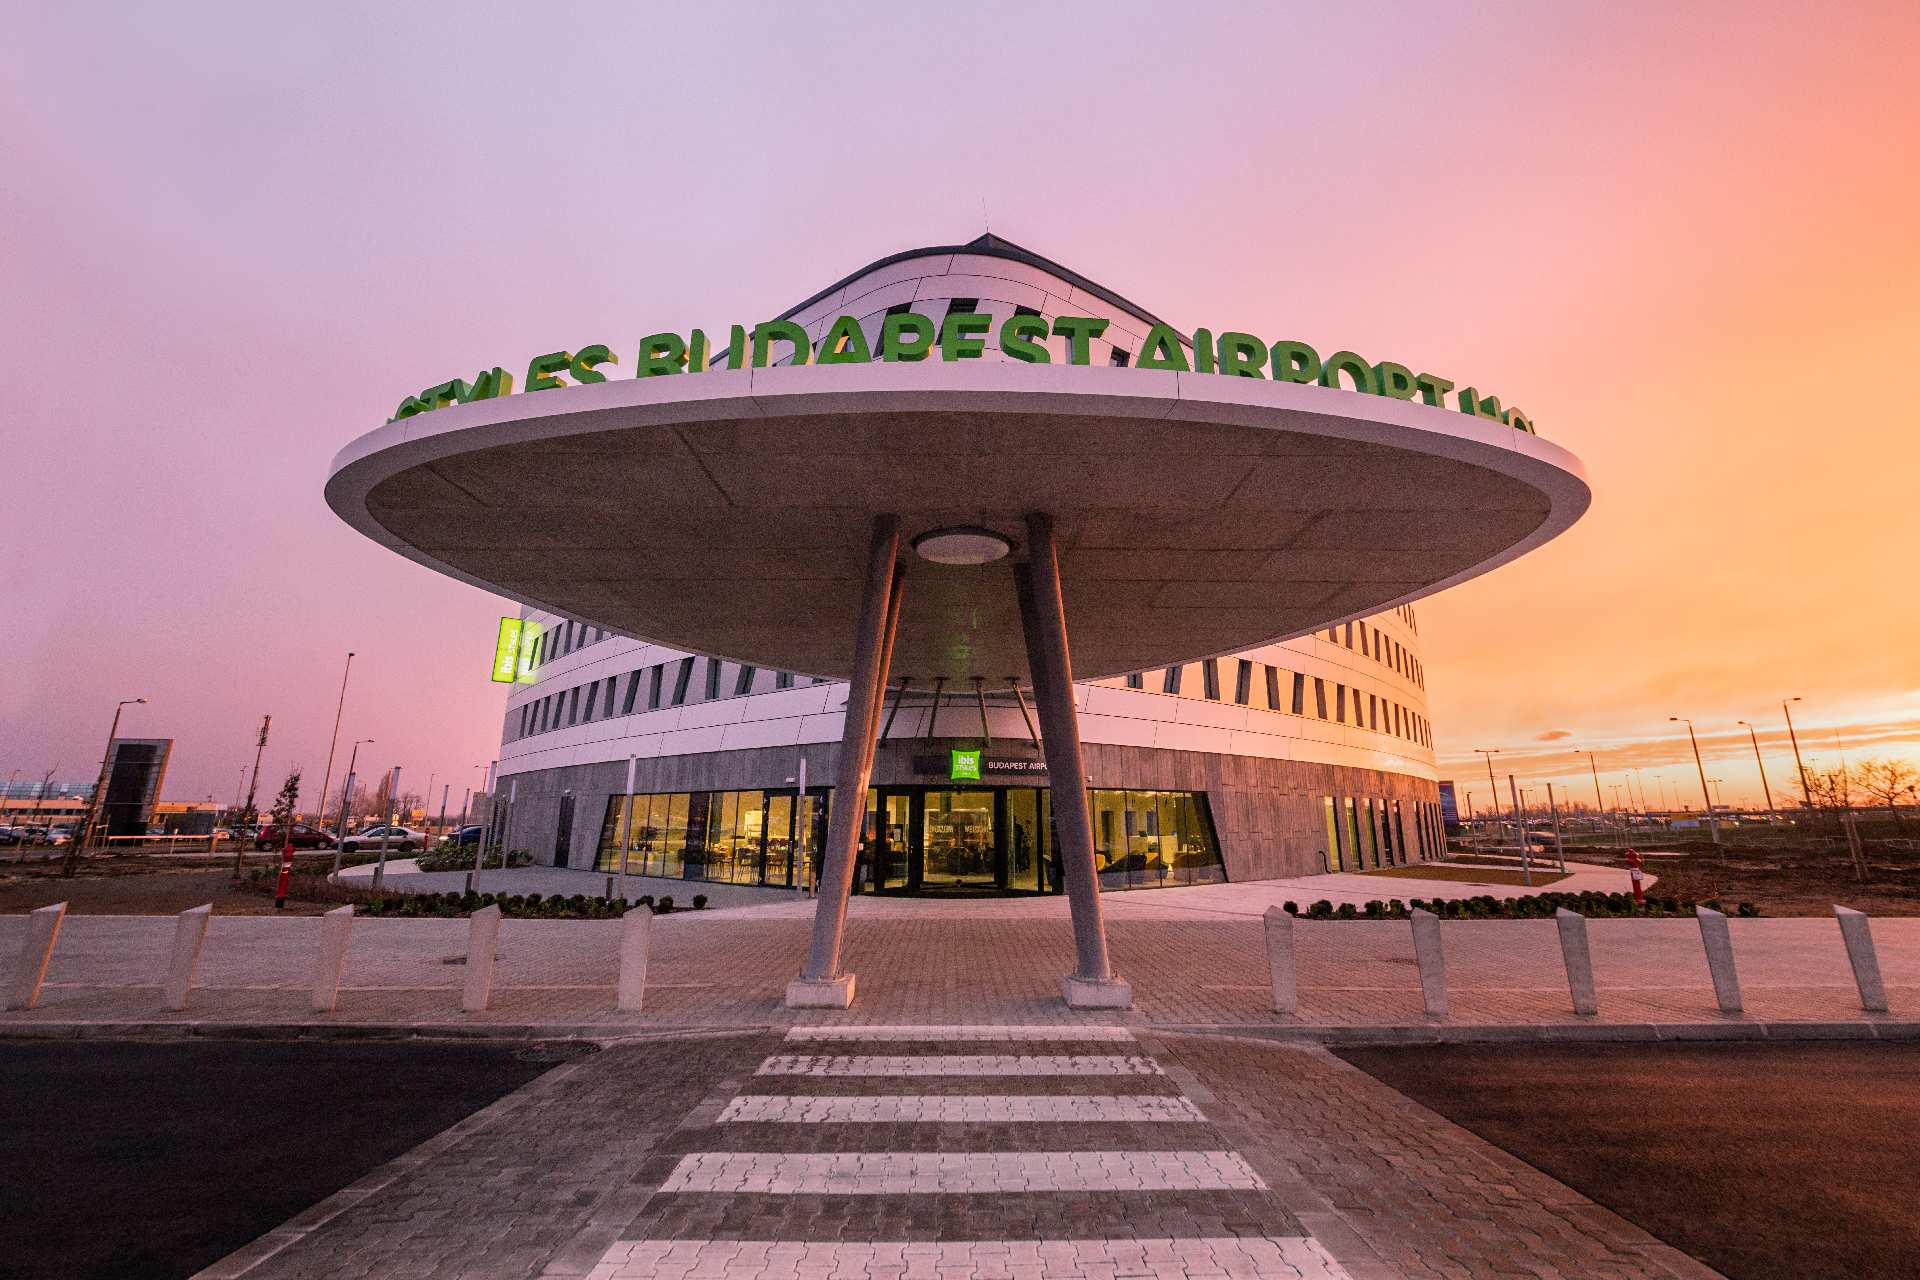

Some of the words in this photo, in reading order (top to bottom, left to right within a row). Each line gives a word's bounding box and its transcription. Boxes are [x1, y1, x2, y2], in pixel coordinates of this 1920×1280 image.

[636, 312, 1110, 379] BUDAPEST
[1136, 323, 1455, 408] AIRPORT
[958, 755, 975, 764] ibis
[988, 761, 1027, 770] BUDAPEST
